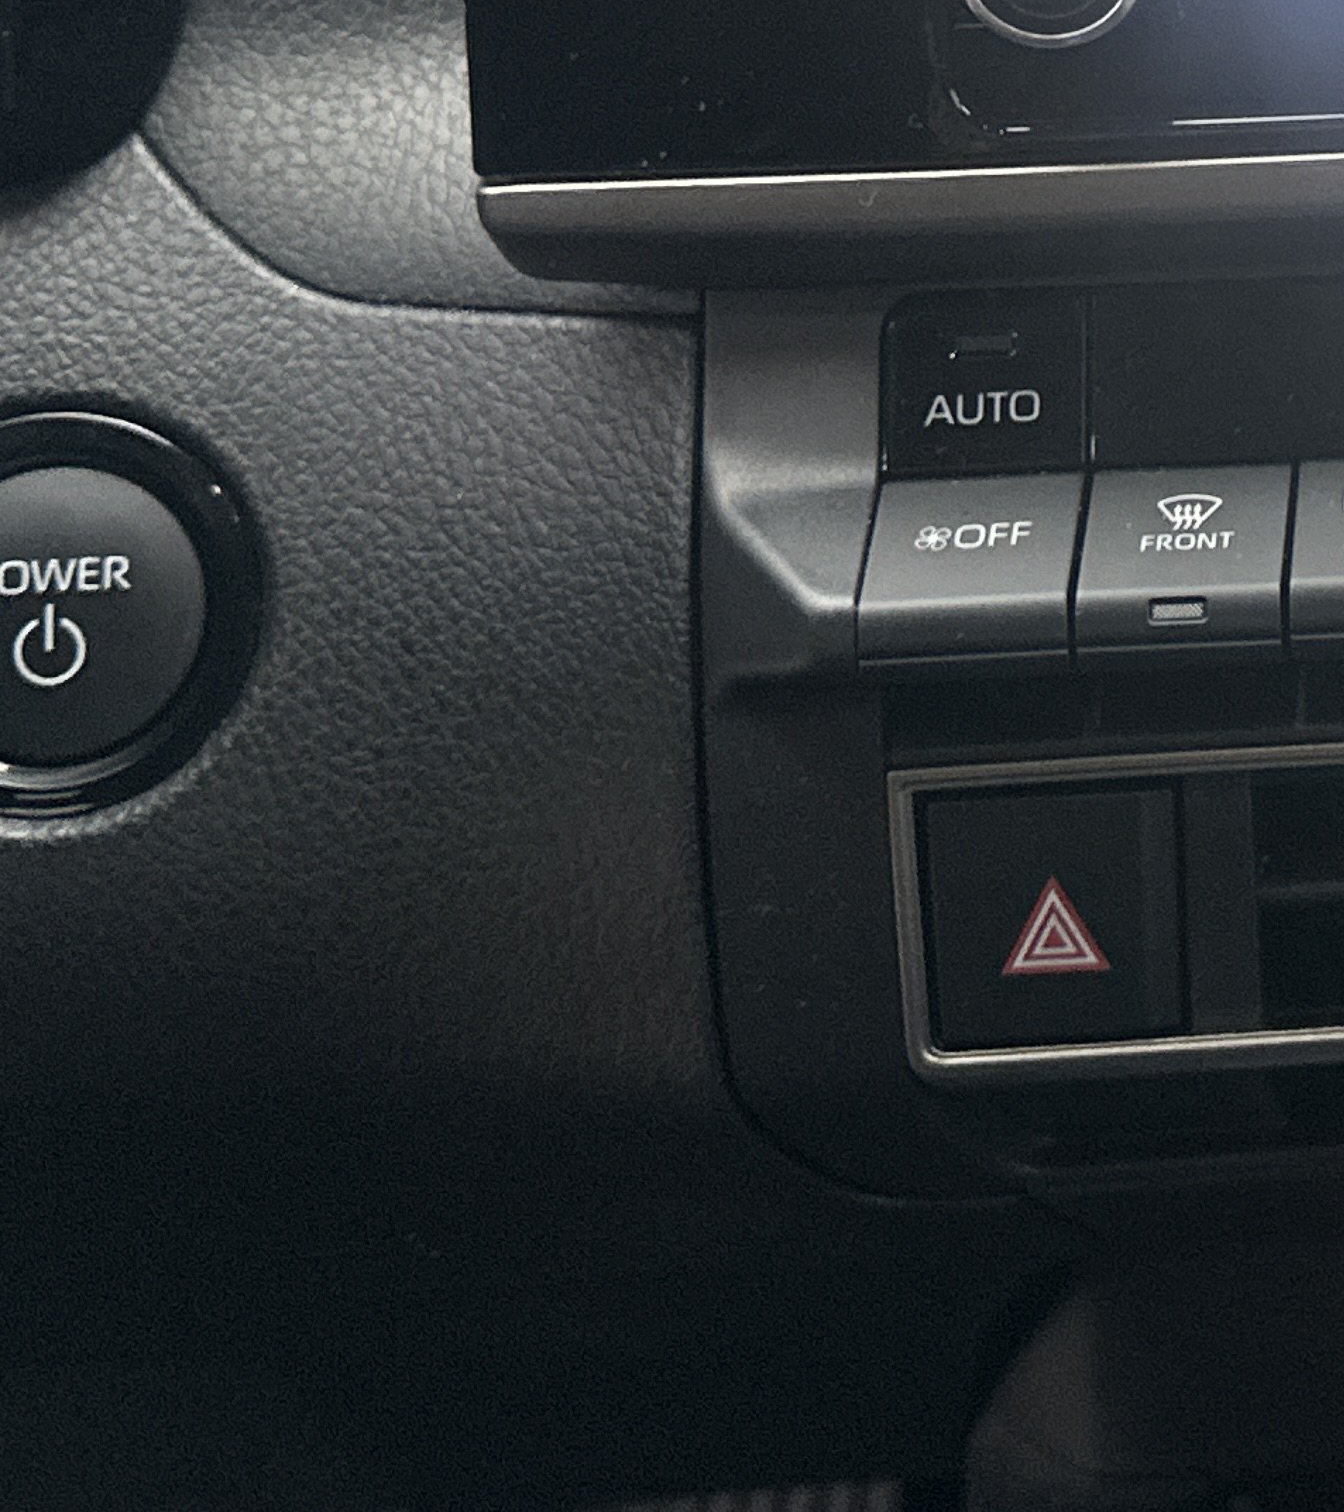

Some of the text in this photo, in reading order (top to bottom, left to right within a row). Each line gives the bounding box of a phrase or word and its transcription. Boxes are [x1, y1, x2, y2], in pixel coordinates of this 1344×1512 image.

[925, 390, 1040, 426] AUTO
[954, 521, 1032, 549] OFF
[1140, 530, 1234, 552] FRONT
